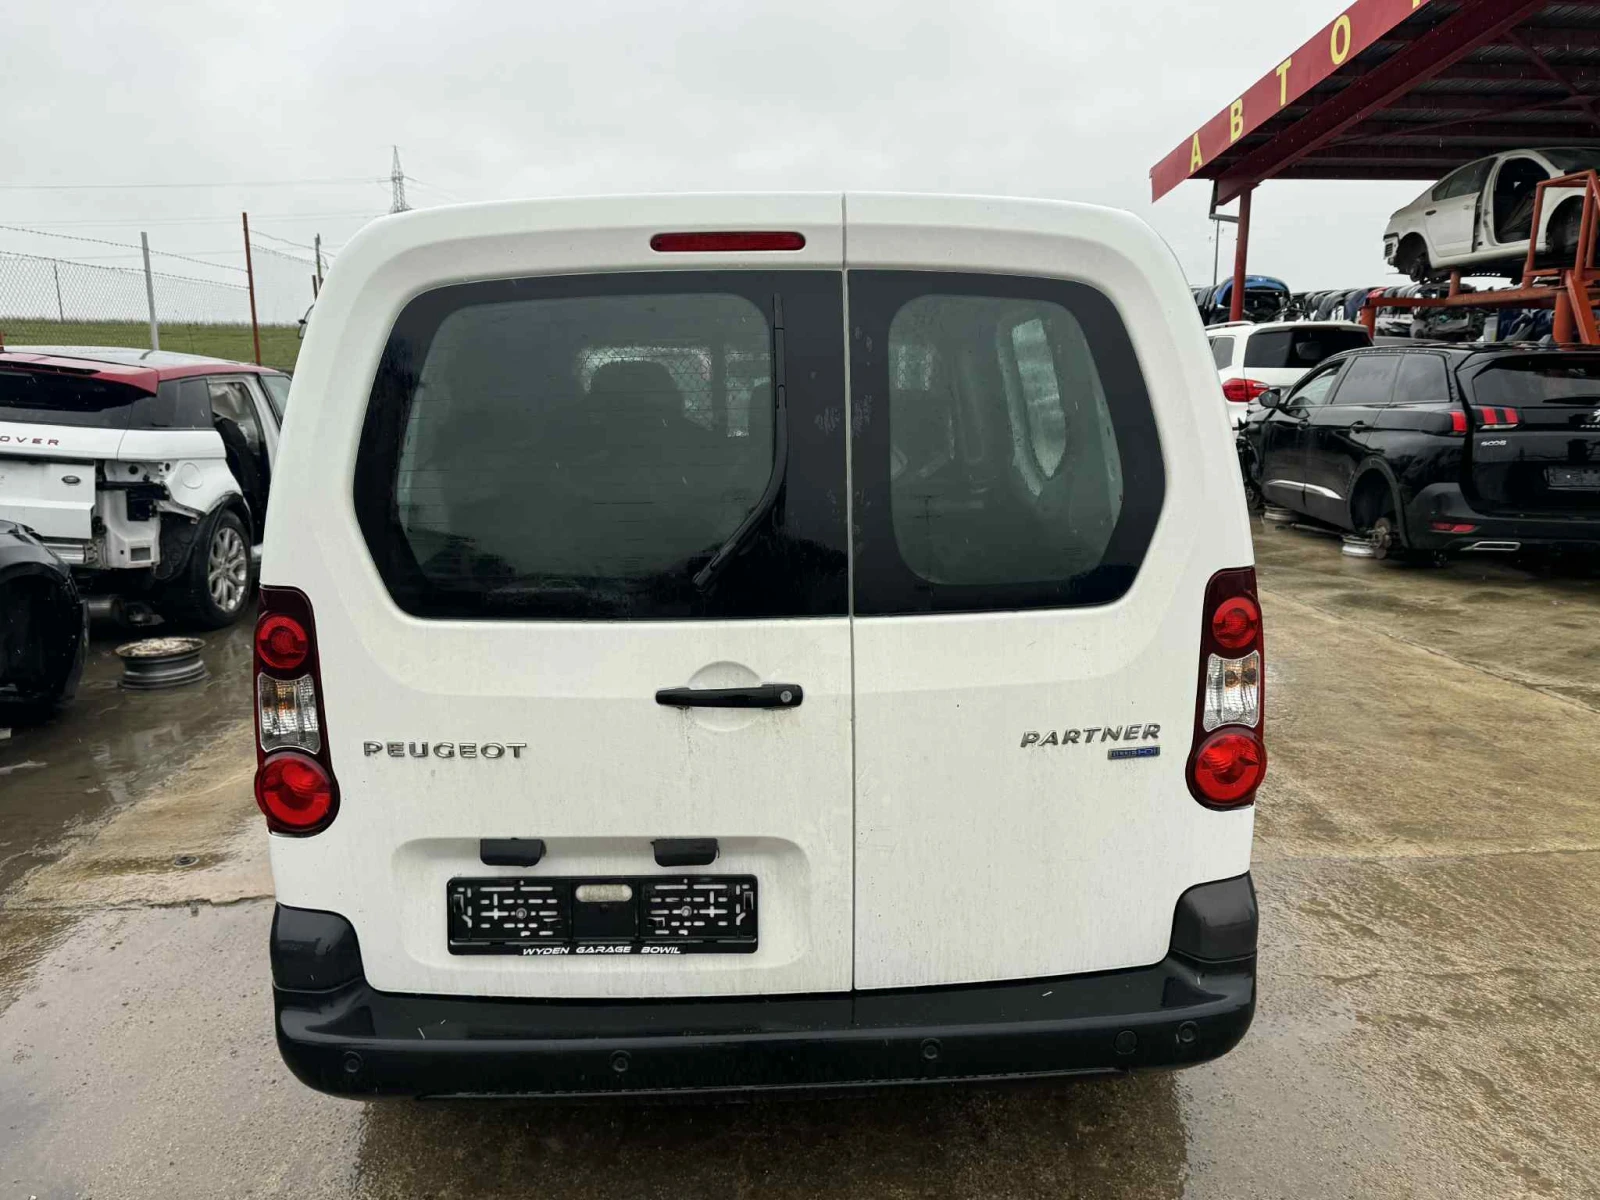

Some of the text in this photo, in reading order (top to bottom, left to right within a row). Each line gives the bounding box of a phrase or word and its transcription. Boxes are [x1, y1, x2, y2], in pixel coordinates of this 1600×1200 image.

[1189, 0, 1421, 174] АВТО
[1020, 722, 1161, 748] PARTNER
[363, 741, 527, 759] PEUGEOT
[522, 945, 682, 956] WYDEN GARAGE BOWIL
